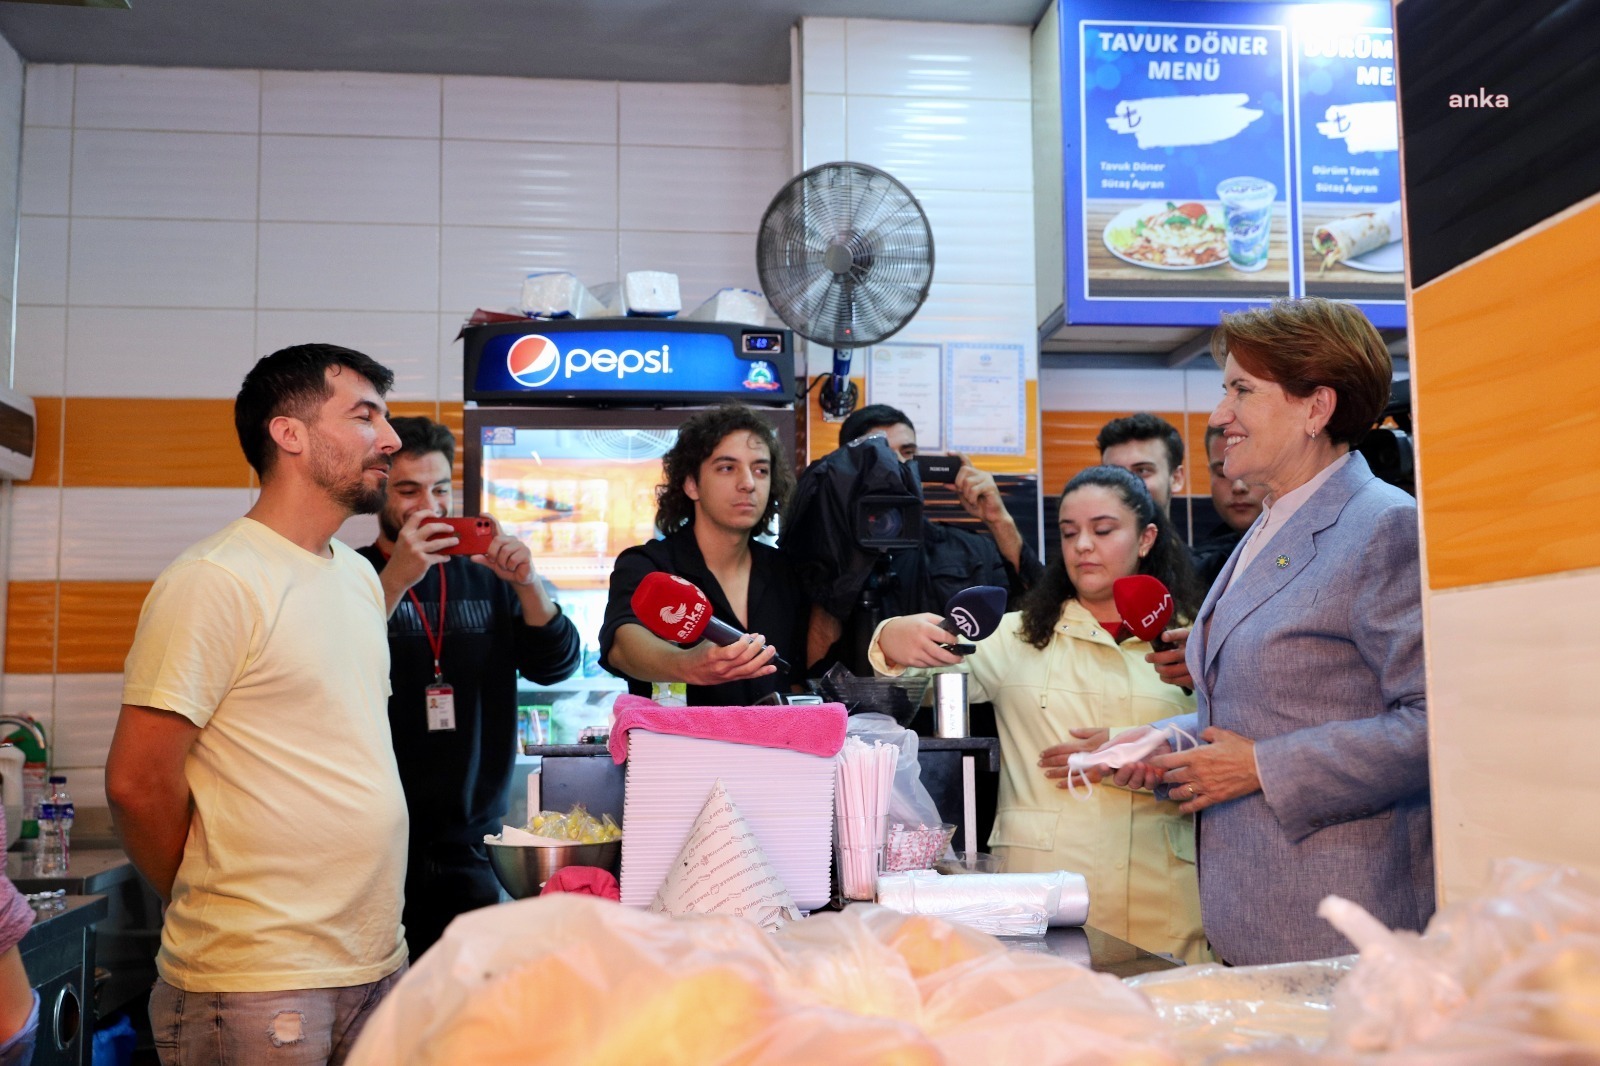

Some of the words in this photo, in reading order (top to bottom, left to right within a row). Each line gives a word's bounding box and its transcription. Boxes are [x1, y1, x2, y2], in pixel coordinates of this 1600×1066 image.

[1099, 32, 1178, 53] TAVUK
[1185, 31, 1269, 55] DÖNER
[1148, 58, 1220, 81] MENÜ
[1356, 65, 1396, 86] ME
[1100, 161, 1130, 171] Tavuk
[1133, 161, 1166, 172] Döner
[1312, 164, 1349, 176] Dürüm
[1349, 165, 1380, 177] Tavuk
[1101, 178, 1130, 190] Sütaş
[1132, 179, 1165, 191] Ayran
[1315, 182, 1345, 195] Sütaş
[1345, 183, 1379, 195] Ayran
[565, 344, 669, 379] pepsi
[677, 603, 703, 637] anka
